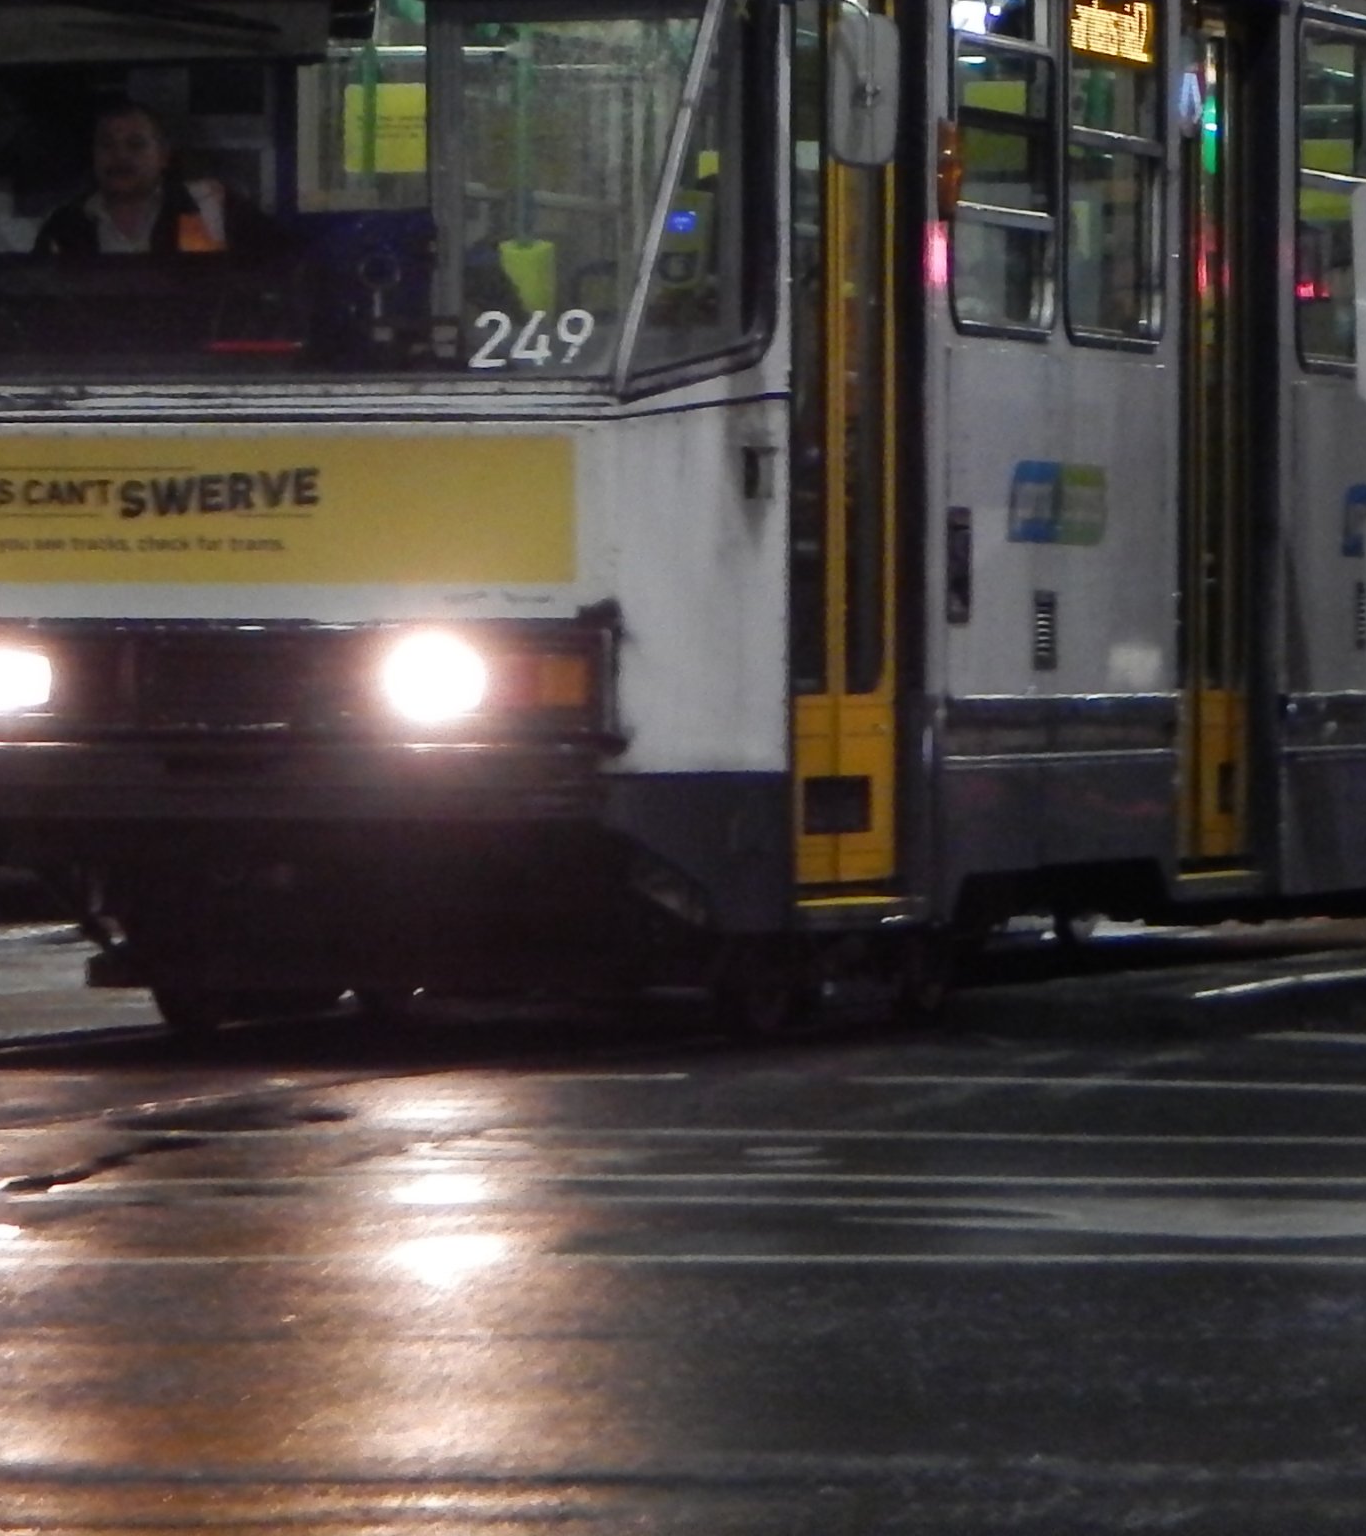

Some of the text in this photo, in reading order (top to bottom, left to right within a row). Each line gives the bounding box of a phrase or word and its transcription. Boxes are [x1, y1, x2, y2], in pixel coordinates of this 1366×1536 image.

[468, 309, 595, 368] 249
[22, 478, 111, 506] CAN'T
[120, 467, 321, 518] SWERVE
[34, 537, 66, 551] see
[137, 536, 189, 552] check
